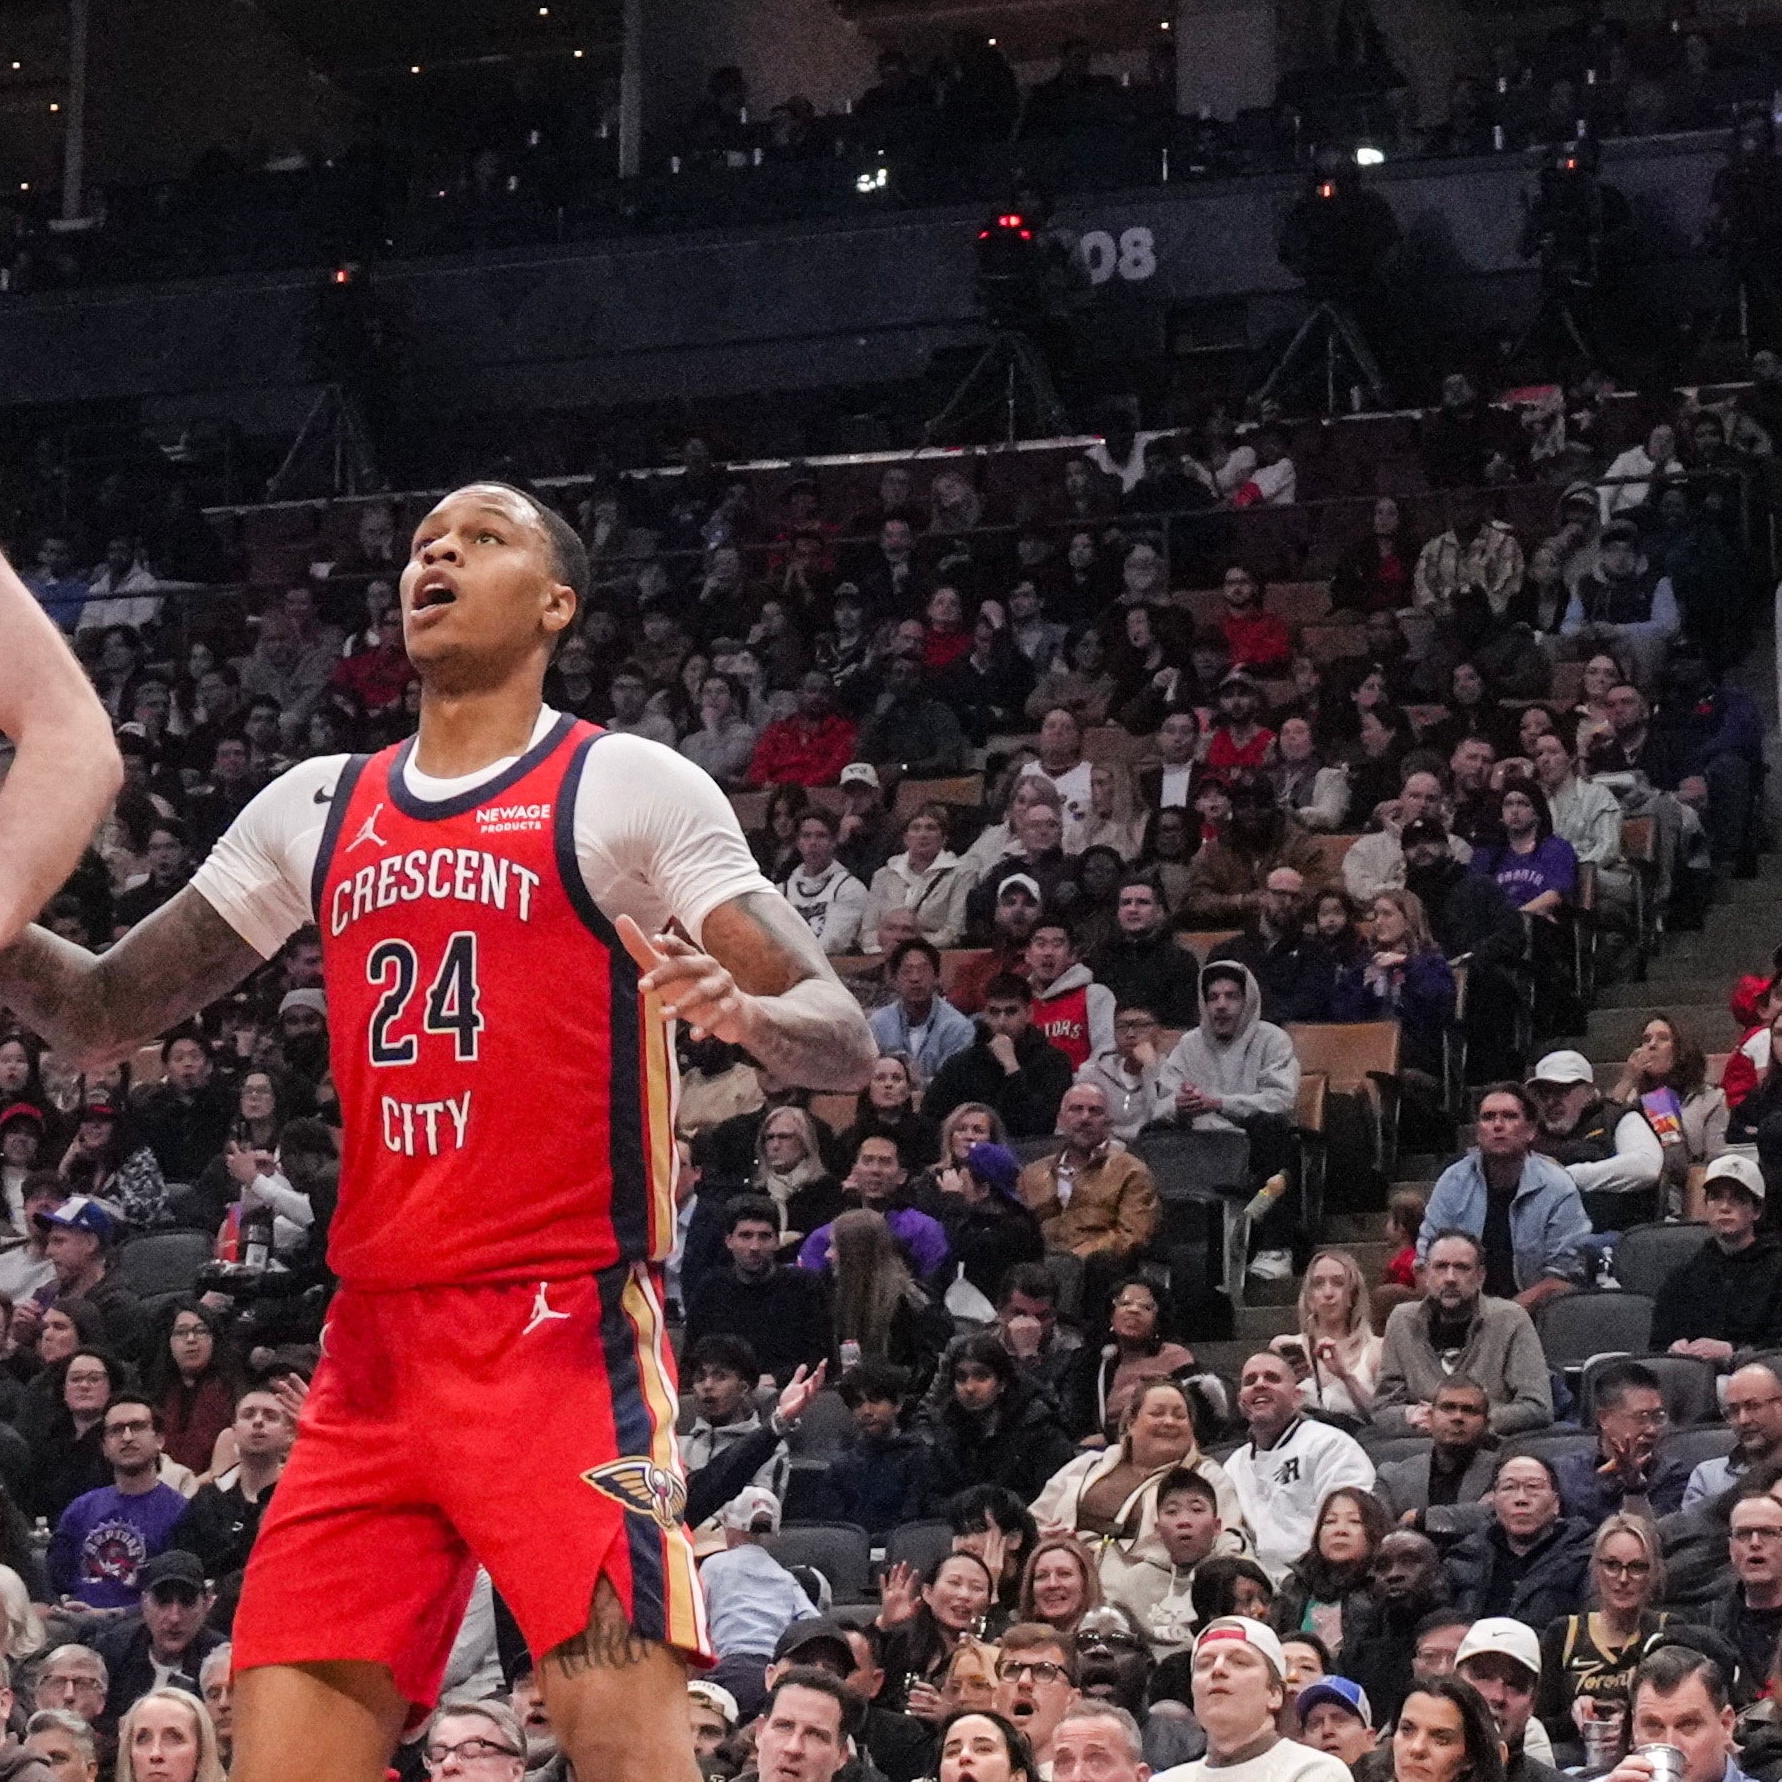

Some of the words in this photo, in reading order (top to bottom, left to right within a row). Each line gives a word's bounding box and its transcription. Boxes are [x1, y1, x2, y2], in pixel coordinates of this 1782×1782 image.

[1080, 226, 1158, 285] 08
[475, 804, 552, 824] NEWAGE
[480, 821, 542, 834] PRODUCTS
[330, 848, 540, 937] CRESCENT
[366, 930, 484, 1068] 24
[381, 1089, 473, 1158] CITY
[1573, 1663, 1636, 1696] Toront
